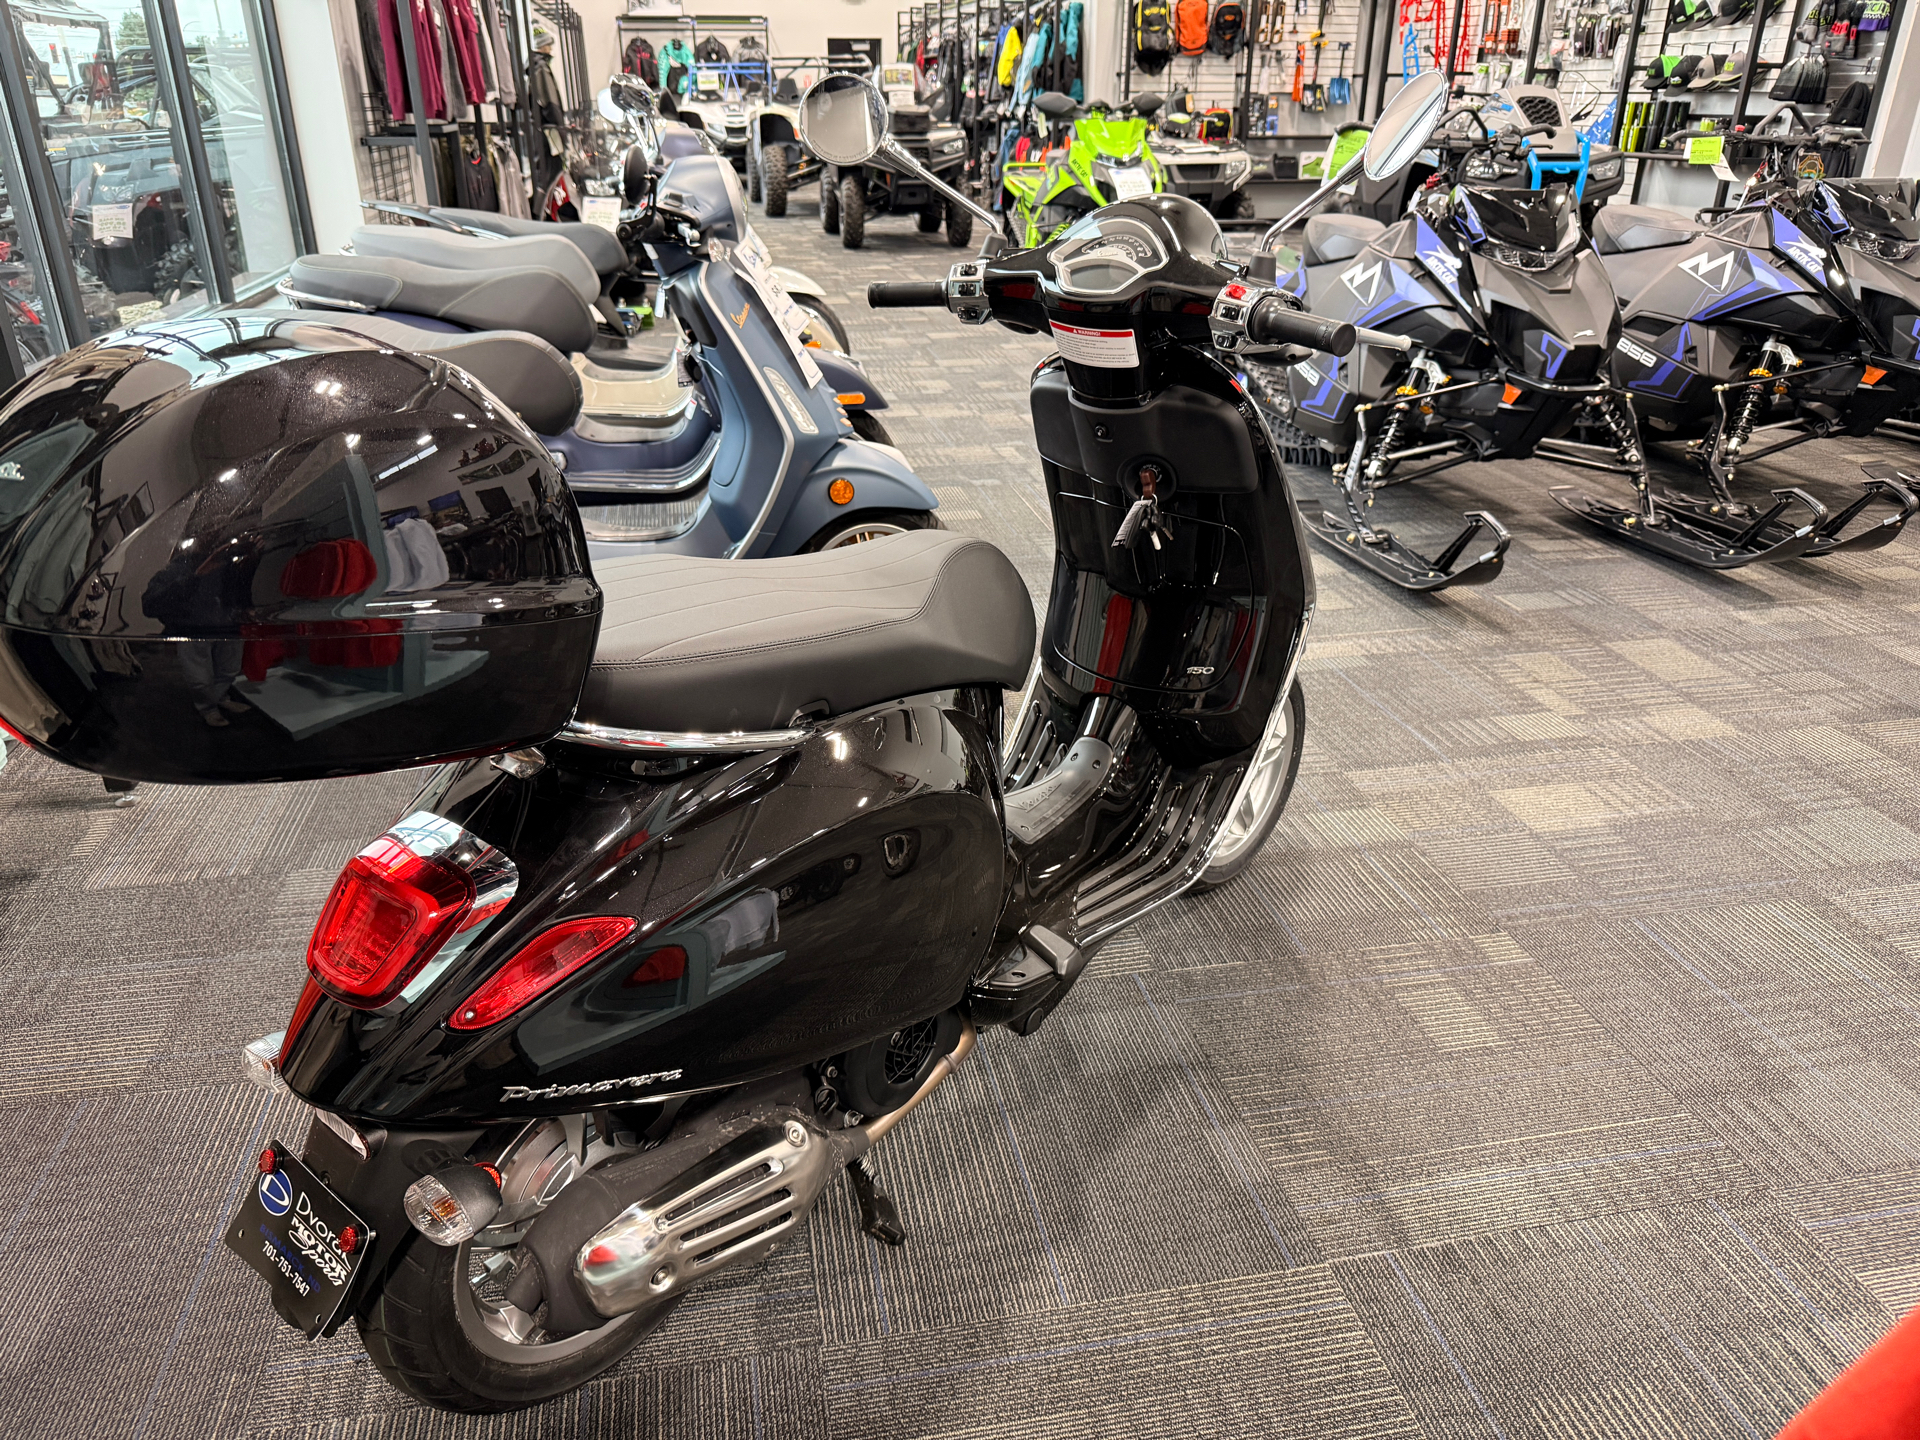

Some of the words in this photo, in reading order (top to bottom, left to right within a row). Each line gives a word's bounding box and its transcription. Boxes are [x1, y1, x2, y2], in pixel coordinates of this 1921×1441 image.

[1079, 169, 1088, 178] CAT
[1425, 256, 1447, 276] ARCTIC
[1441, 271, 1457, 285] CAT
[1786, 246, 1810, 266] ARCTIC
[1806, 261, 1822, 274] CAT
[1077, 329, 1101, 337] WARNING!
[1616, 337, 1657, 368] 858
[1186, 666, 1215, 675] 150
[499, 1068, 684, 1102] Primavera
[288, 1229, 343, 1286] Sports
[291, 1216, 347, 1282] MOTOR
[262, 1240, 311, 1297] 701-751-7547
[307, 1274, 321, 1293] ND
